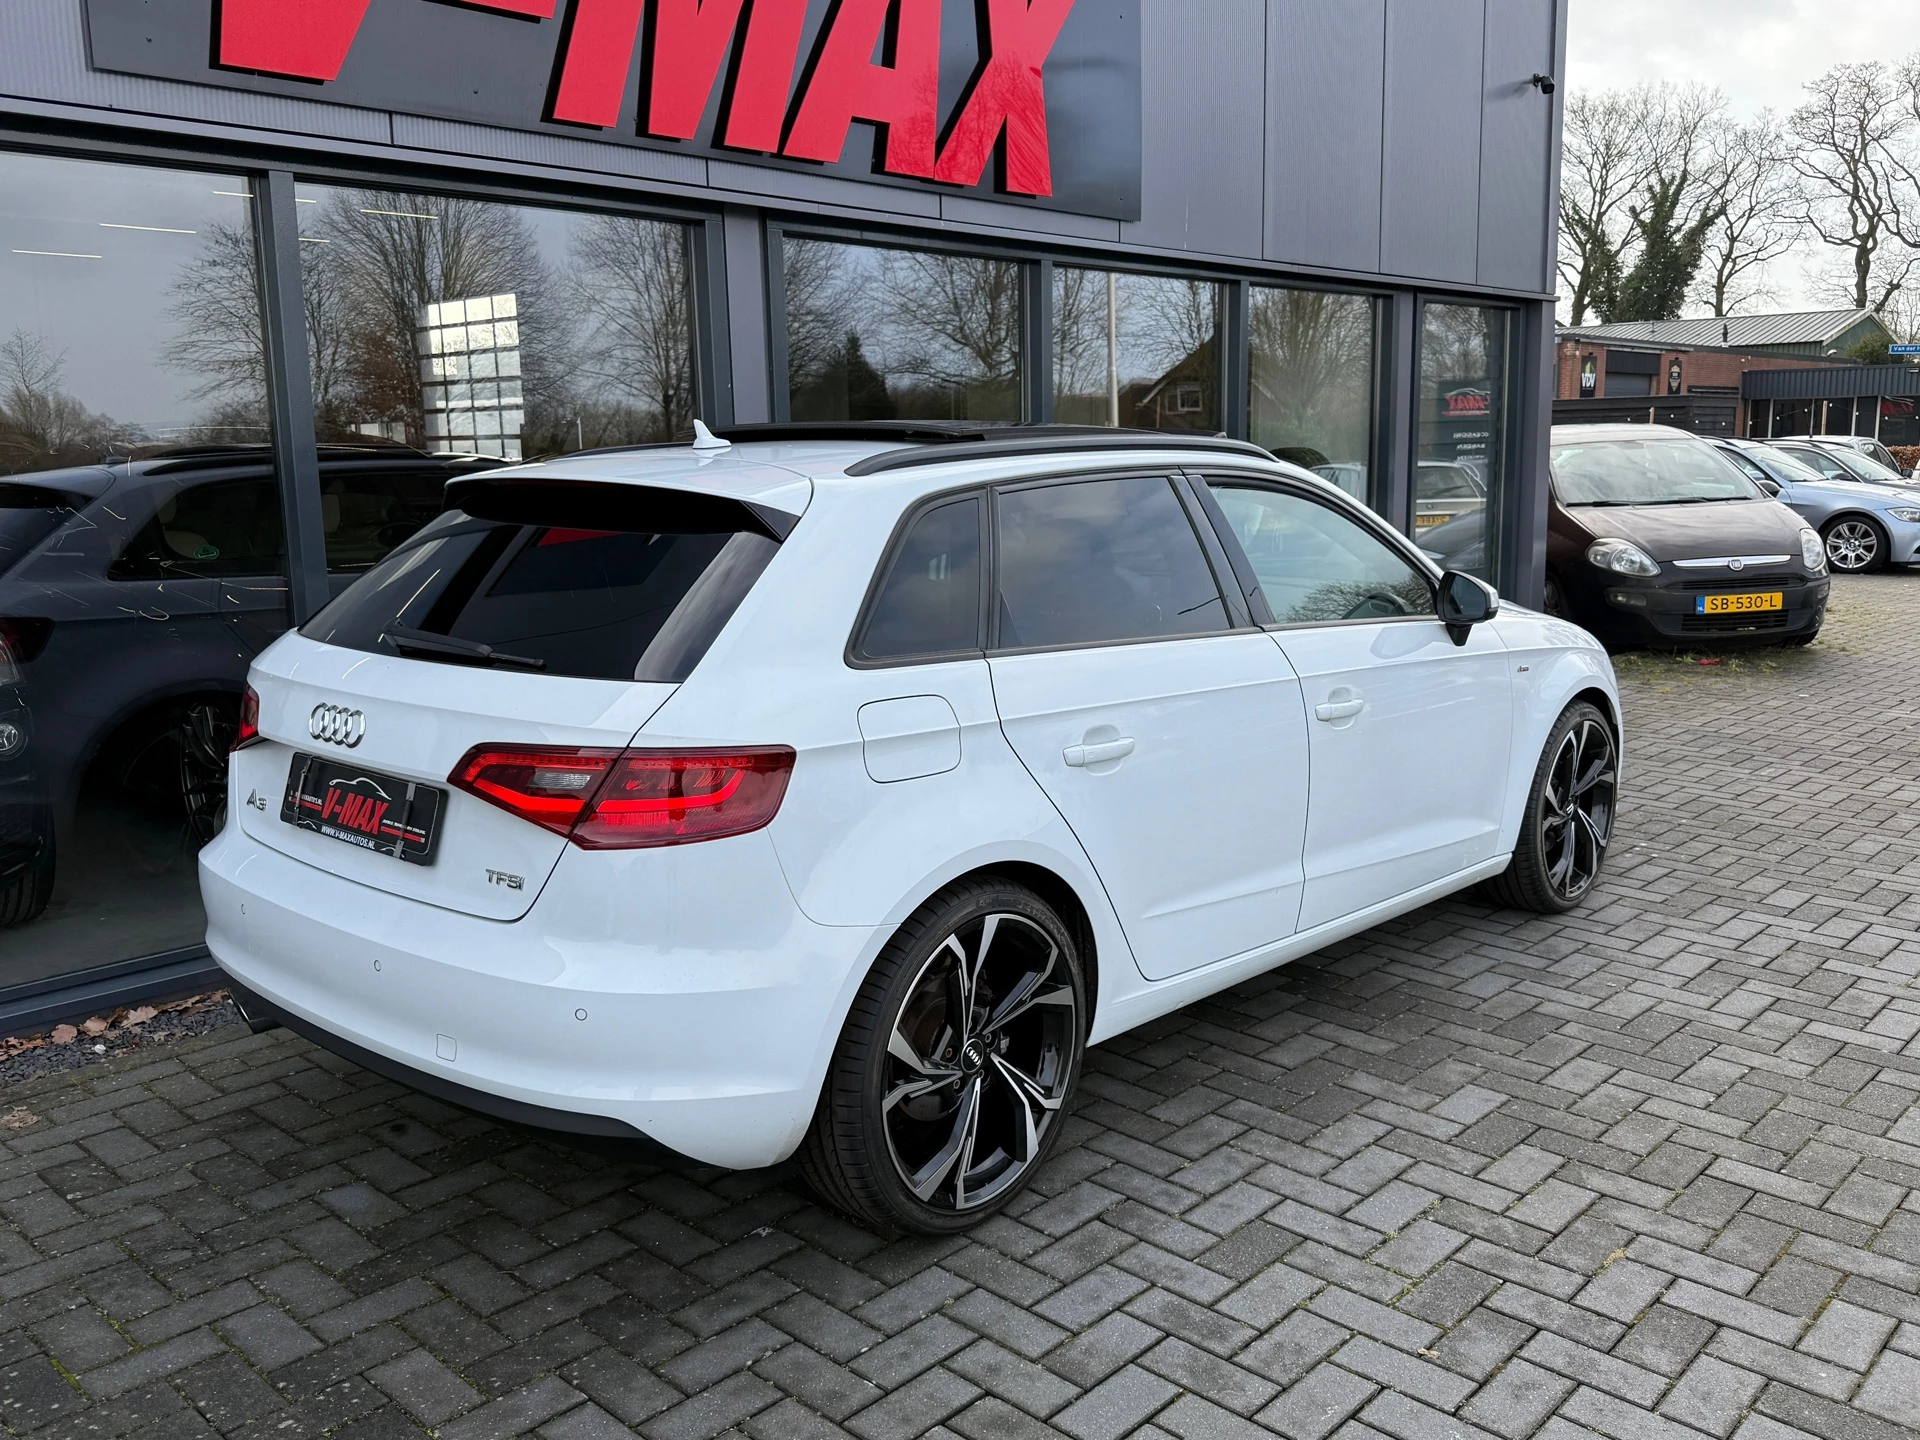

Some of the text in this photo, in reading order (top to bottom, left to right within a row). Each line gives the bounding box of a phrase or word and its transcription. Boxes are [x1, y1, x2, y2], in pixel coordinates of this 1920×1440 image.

[1710, 595, 1777, 611] SB-530-L
[246, 788, 267, 811] A3
[322, 787, 389, 835] V-MAX
[321, 825, 375, 850] WWW.V-MAXAUTOS.NL
